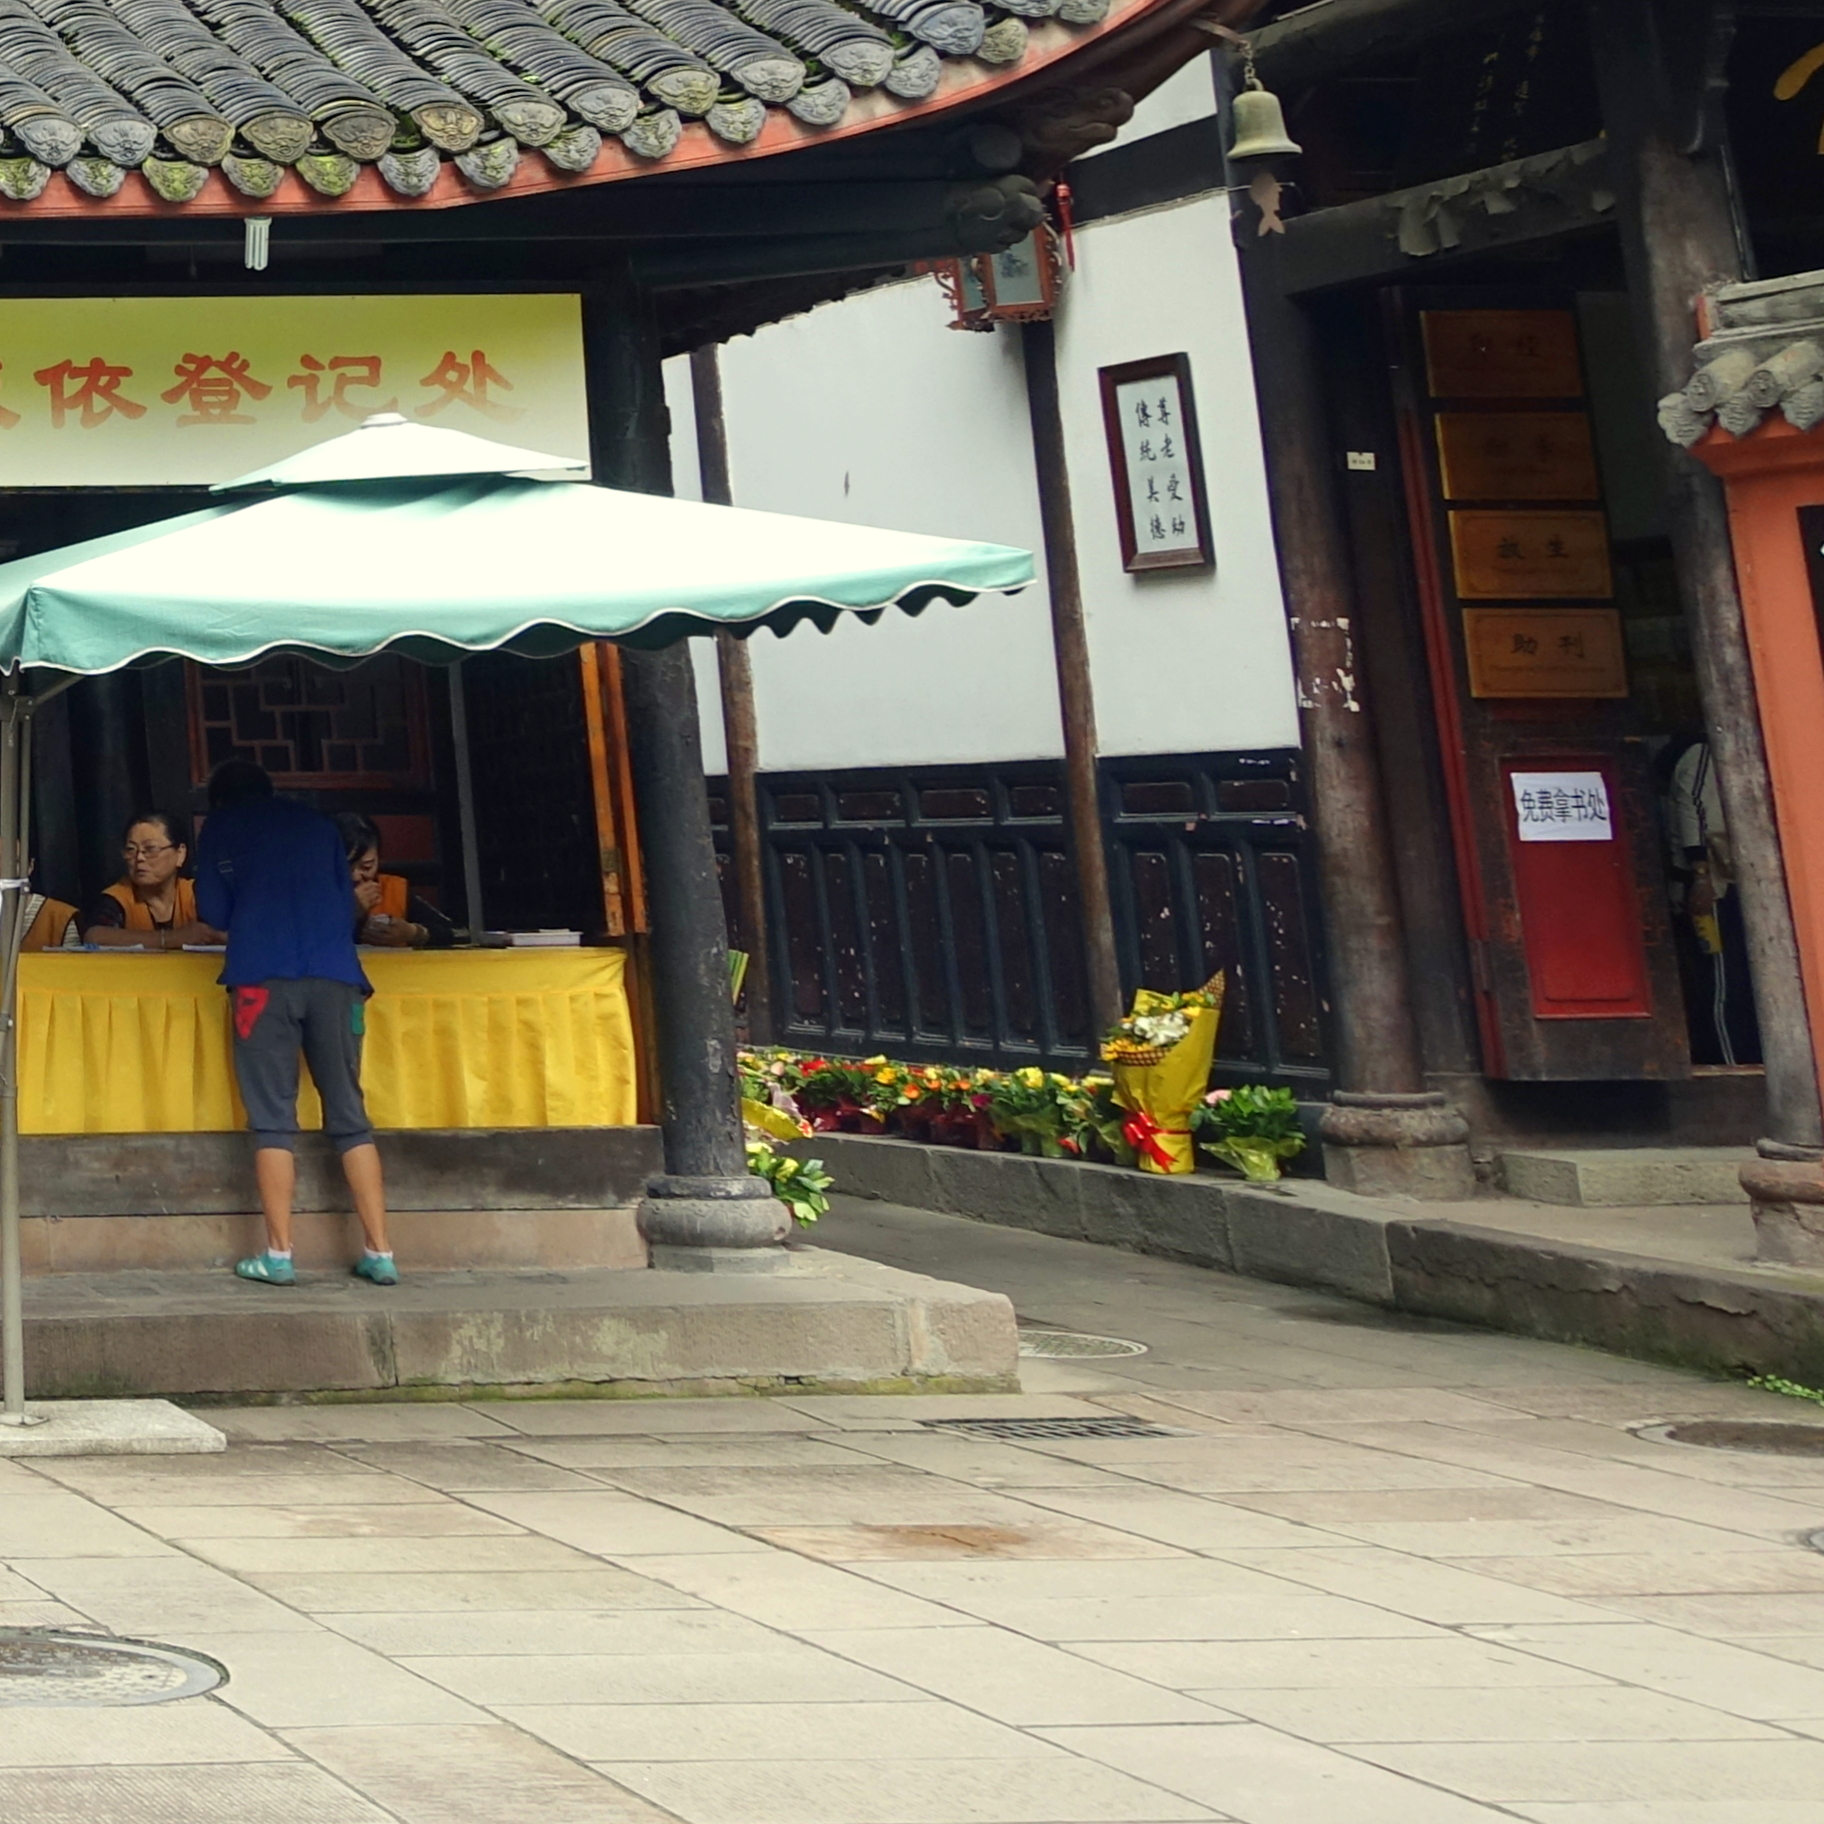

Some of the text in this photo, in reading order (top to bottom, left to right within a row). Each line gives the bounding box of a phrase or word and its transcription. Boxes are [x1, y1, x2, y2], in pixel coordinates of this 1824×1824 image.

[1520, 787, 1607, 823] 免费拿书处
